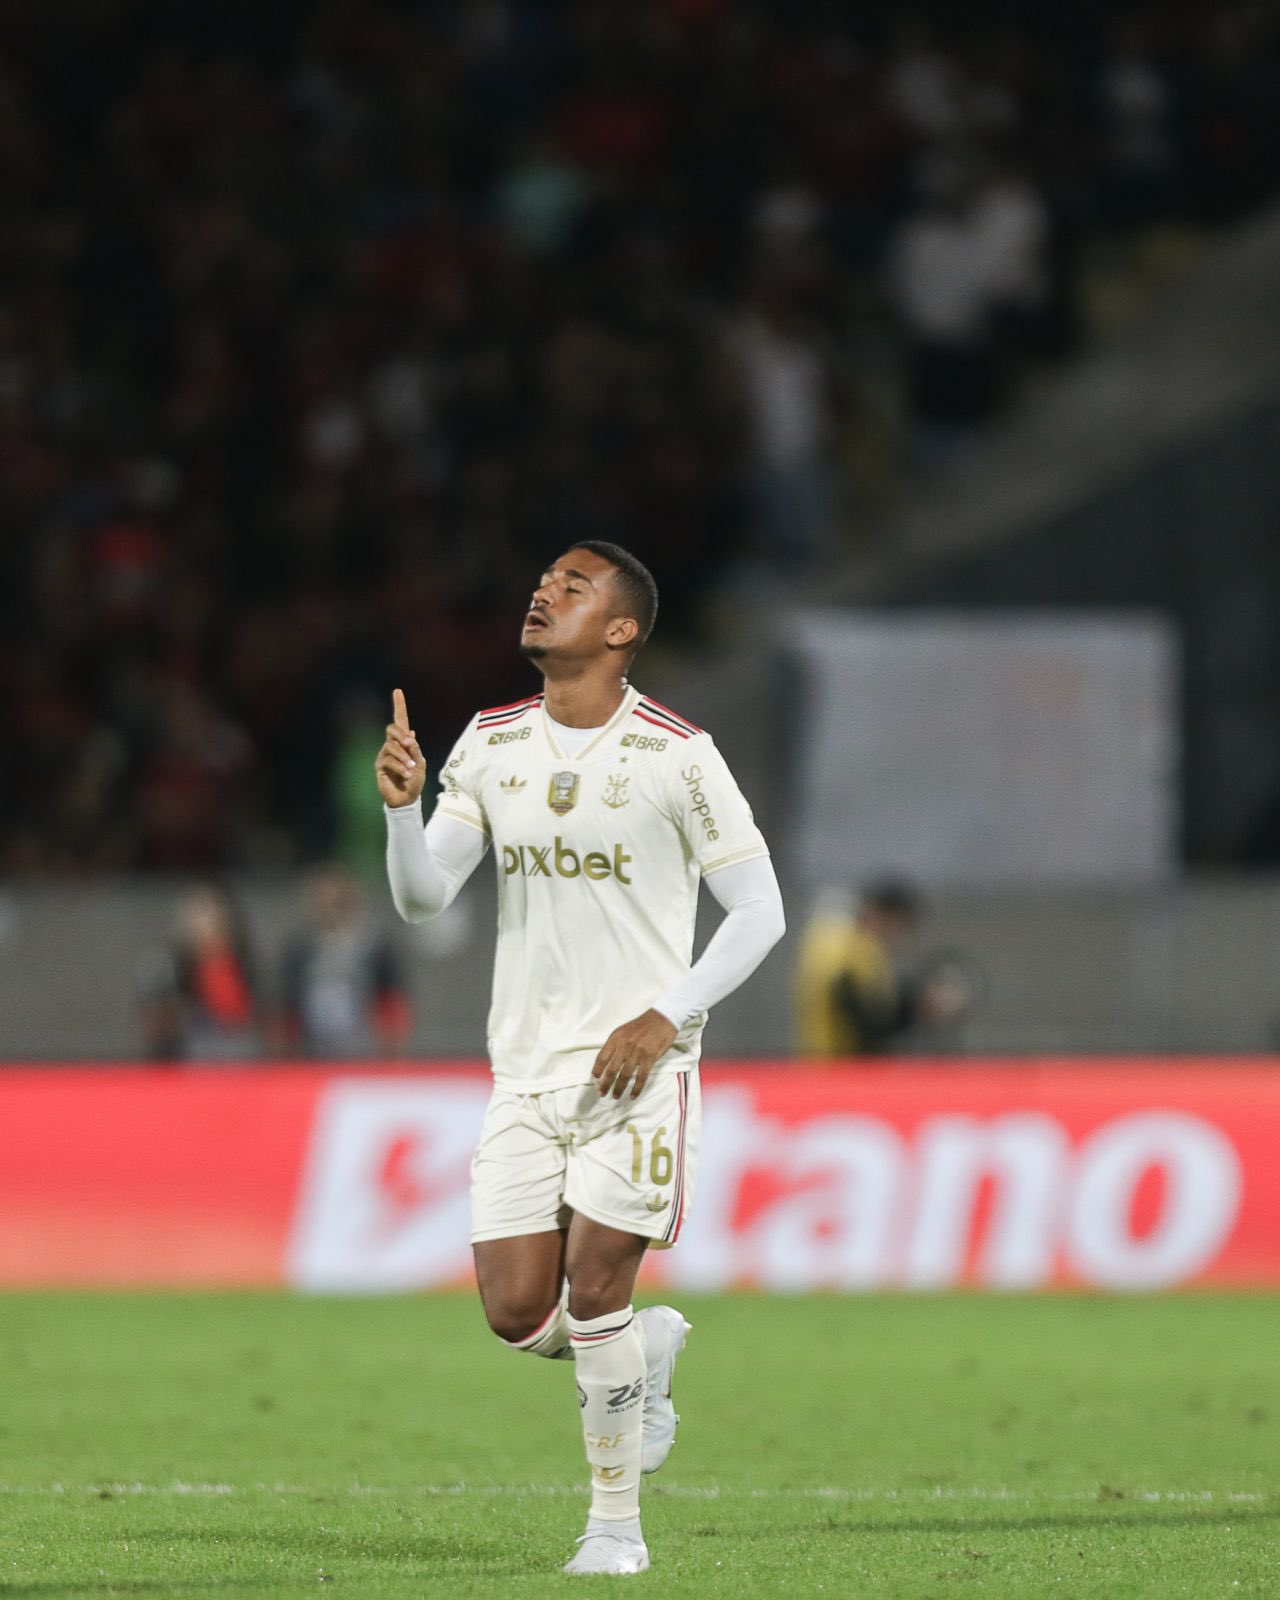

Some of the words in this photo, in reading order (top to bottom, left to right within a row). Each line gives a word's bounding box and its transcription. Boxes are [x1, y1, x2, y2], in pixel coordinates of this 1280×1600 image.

[635, 735, 669, 752] BRB
[681, 764, 720, 842] Shopee
[503, 835, 632, 886] pixbet
[626, 1123, 673, 1186] 16
[285, 1078, 1243, 1293] Btano
[606, 1376, 643, 1408] Zé
